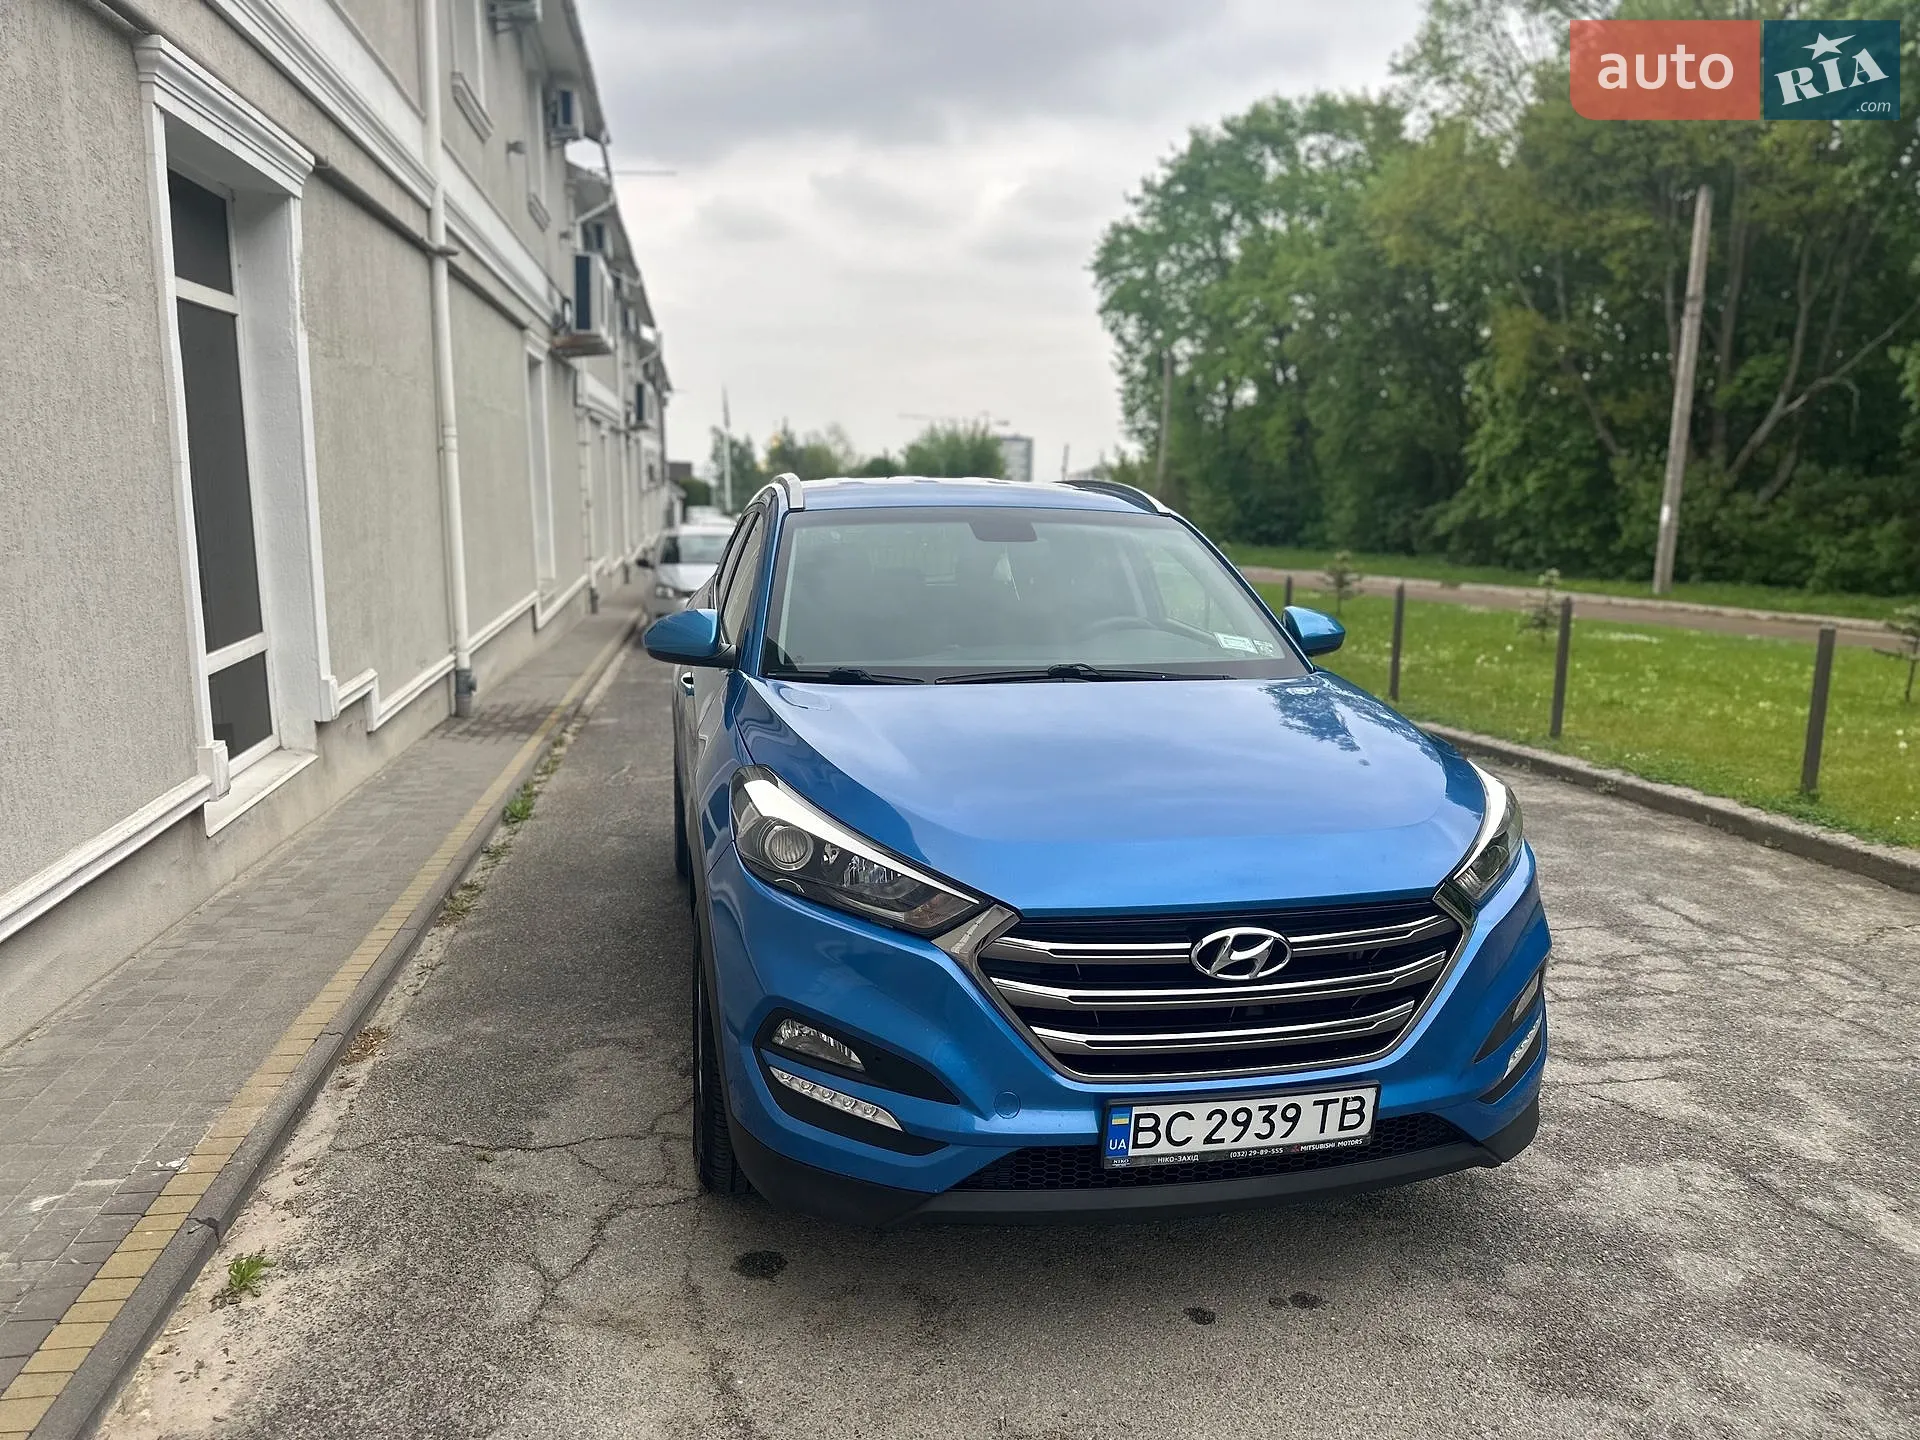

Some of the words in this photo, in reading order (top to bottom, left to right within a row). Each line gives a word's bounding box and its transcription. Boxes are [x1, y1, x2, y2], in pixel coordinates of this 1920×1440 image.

[1131, 1111, 1195, 1150] BC
[1202, 1102, 1302, 1145] 2939
[1313, 1095, 1366, 1134] TB
[1109, 1139, 1127, 1151] UA
[1300, 1143, 1335, 1151] MITSUBISHI
[1337, 1139, 1363, 1147] MOTORS
